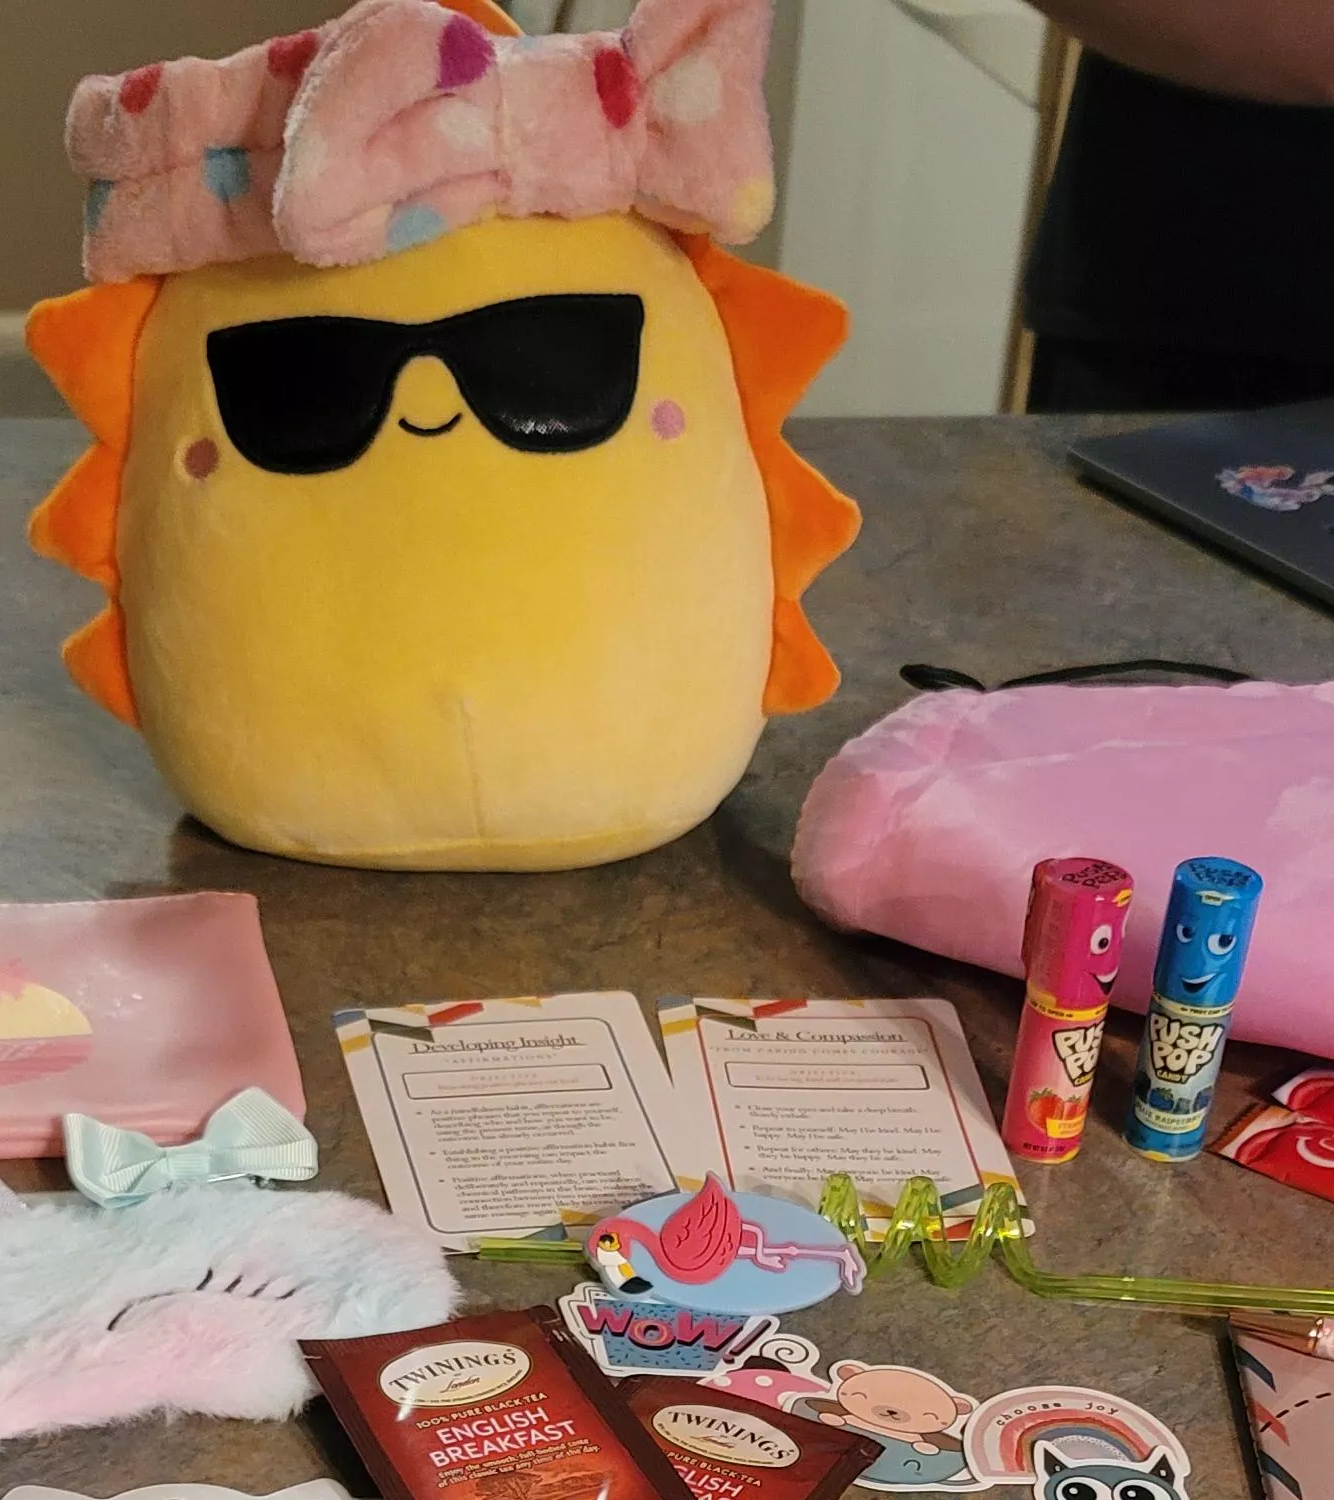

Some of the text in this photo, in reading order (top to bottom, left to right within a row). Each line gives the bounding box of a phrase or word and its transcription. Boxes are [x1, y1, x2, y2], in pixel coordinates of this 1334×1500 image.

[413, 1033, 578, 1055] Developing Insight
[726, 1028, 904, 1044] Love & Compassion
[1150, 1013, 1225, 1052] PUSH
[1153, 1040, 1213, 1076] POP
[575, 1302, 772, 1365] WOW!
[388, 1352, 517, 1392] TWININGS
[439, 1375, 481, 1394] London
[416, 1391, 548, 1430] 100% PURE BLACK TEA
[435, 1406, 550, 1446] ENGLISH
[995, 1402, 1122, 1427] choose joy
[428, 1420, 578, 1468] BREAKFAST
[667, 1410, 791, 1461] TWININGS
[437, 1467, 465, 1480] Enjoy
[465, 1462, 481, 1474] the
[567, 1437, 590, 1448] taste
[437, 1479, 449, 1489] of
[449, 1475, 468, 1485] this
[468, 1467, 499, 1480] classic
[499, 1464, 516, 1474] tea
[515, 1459, 533, 1473] any
[532, 1455, 553, 1466] time
[554, 1451, 565, 1461] of
[565, 1447, 582, 1458] the
[667, 1450, 763, 1488] PURE BLACK TEA
